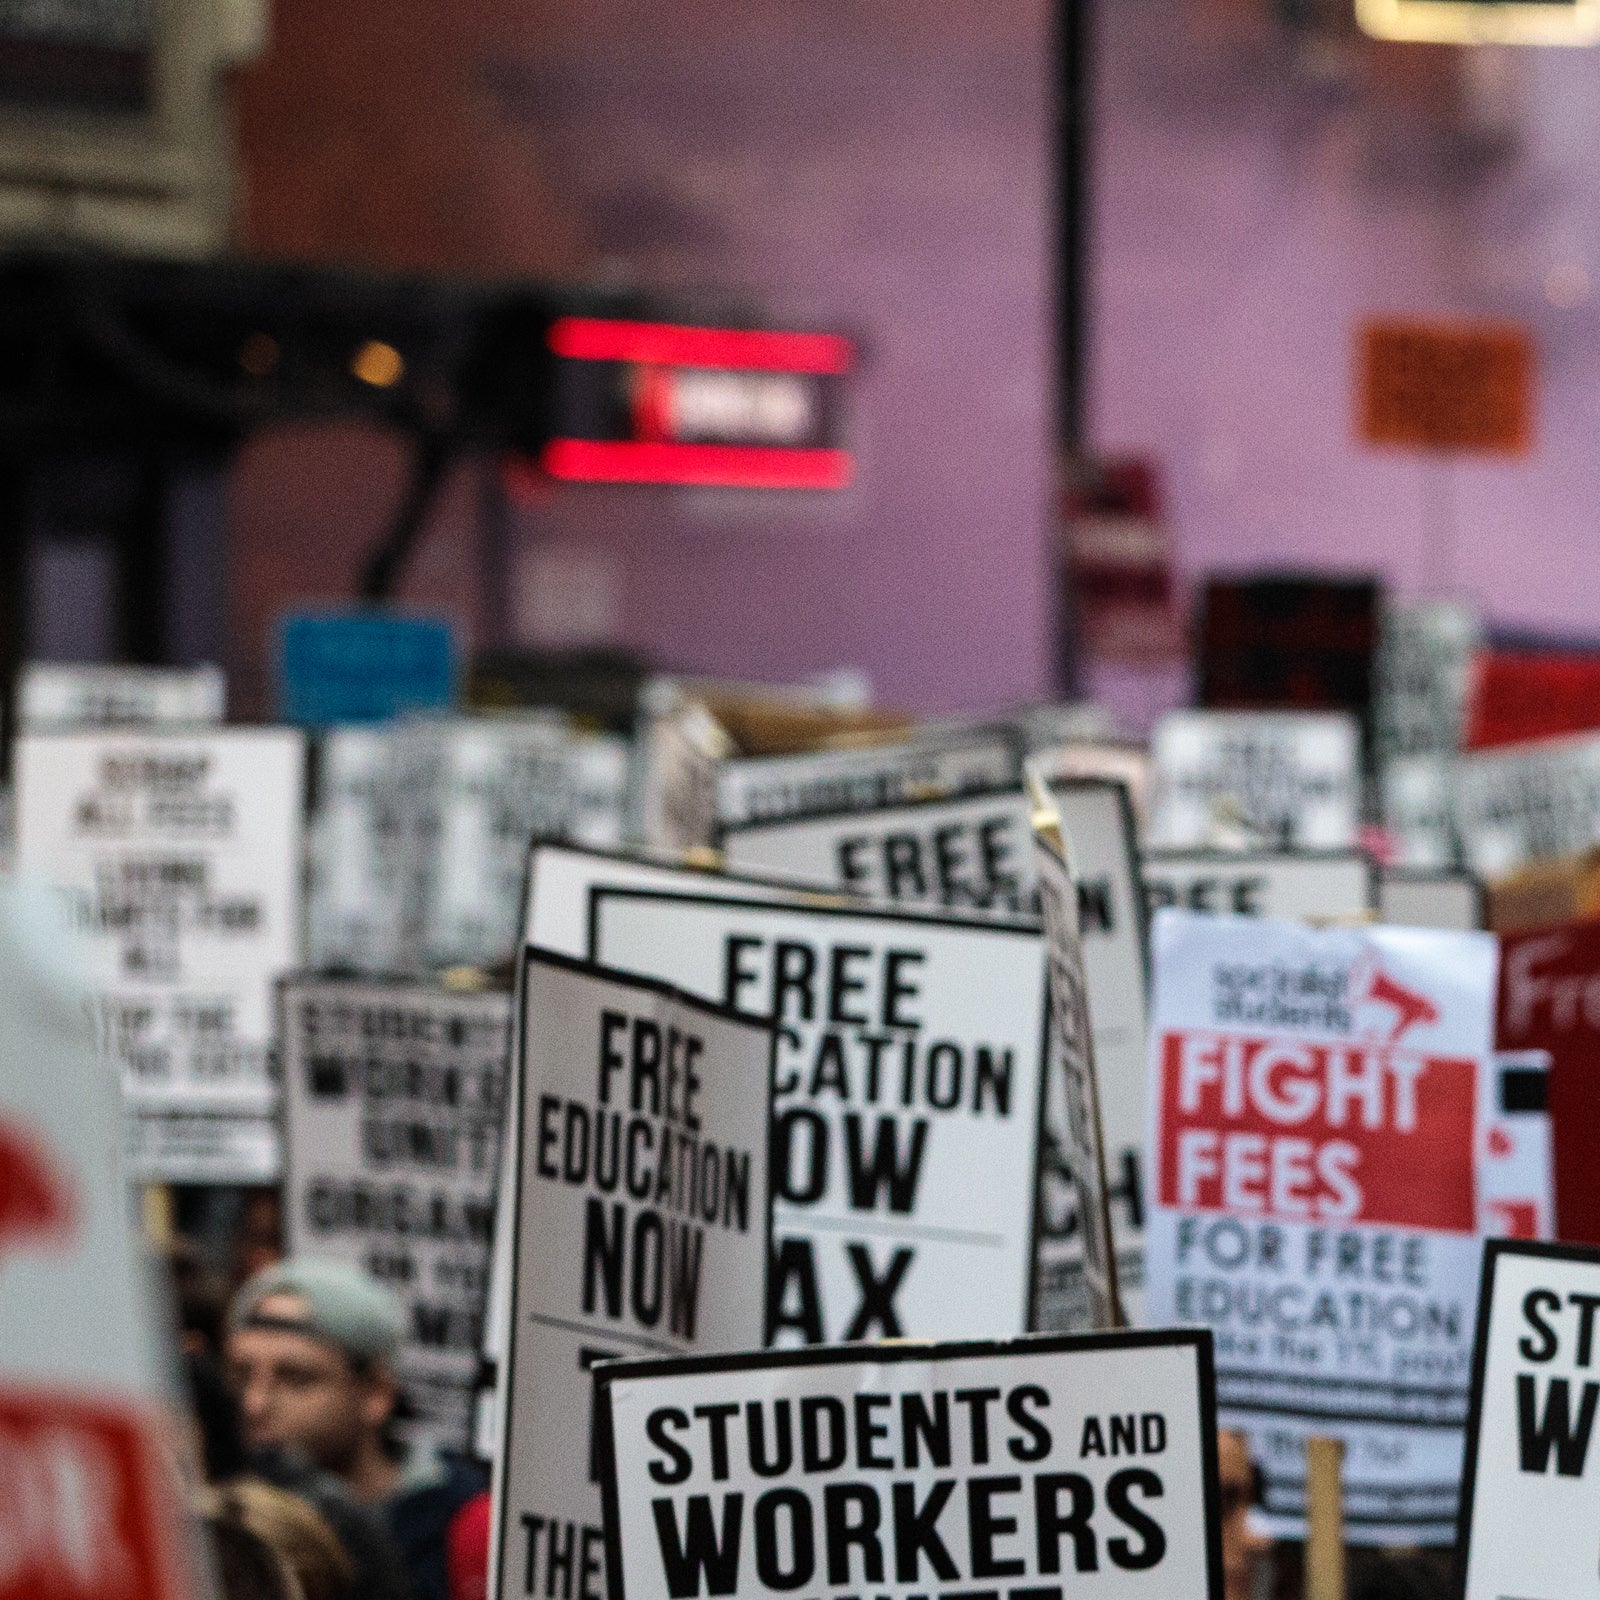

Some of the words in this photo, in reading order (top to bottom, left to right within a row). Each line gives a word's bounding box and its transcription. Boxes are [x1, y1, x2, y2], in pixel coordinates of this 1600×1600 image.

[724, 935, 926, 1031] FREE
[599, 1009, 704, 1129] FREE
[774, 1030, 1014, 1120] CATION
[1178, 1038, 1430, 1133] FIGHT
[537, 1096, 752, 1233] EDUCATION
[775, 1110, 930, 1217] OW
[1178, 1127, 1364, 1223] FEES
[581, 1196, 705, 1342] NOW
[770, 1236, 917, 1345] AX
[1175, 1216, 1289, 1274] FOR
[1305, 1226, 1432, 1289] FREE
[1175, 1279, 1462, 1340] EDUCATION
[645, 1383, 1052, 1486] STUDENTS
[1080, 1412, 1167, 1459] AND
[651, 1469, 1167, 1600] WORKERS
